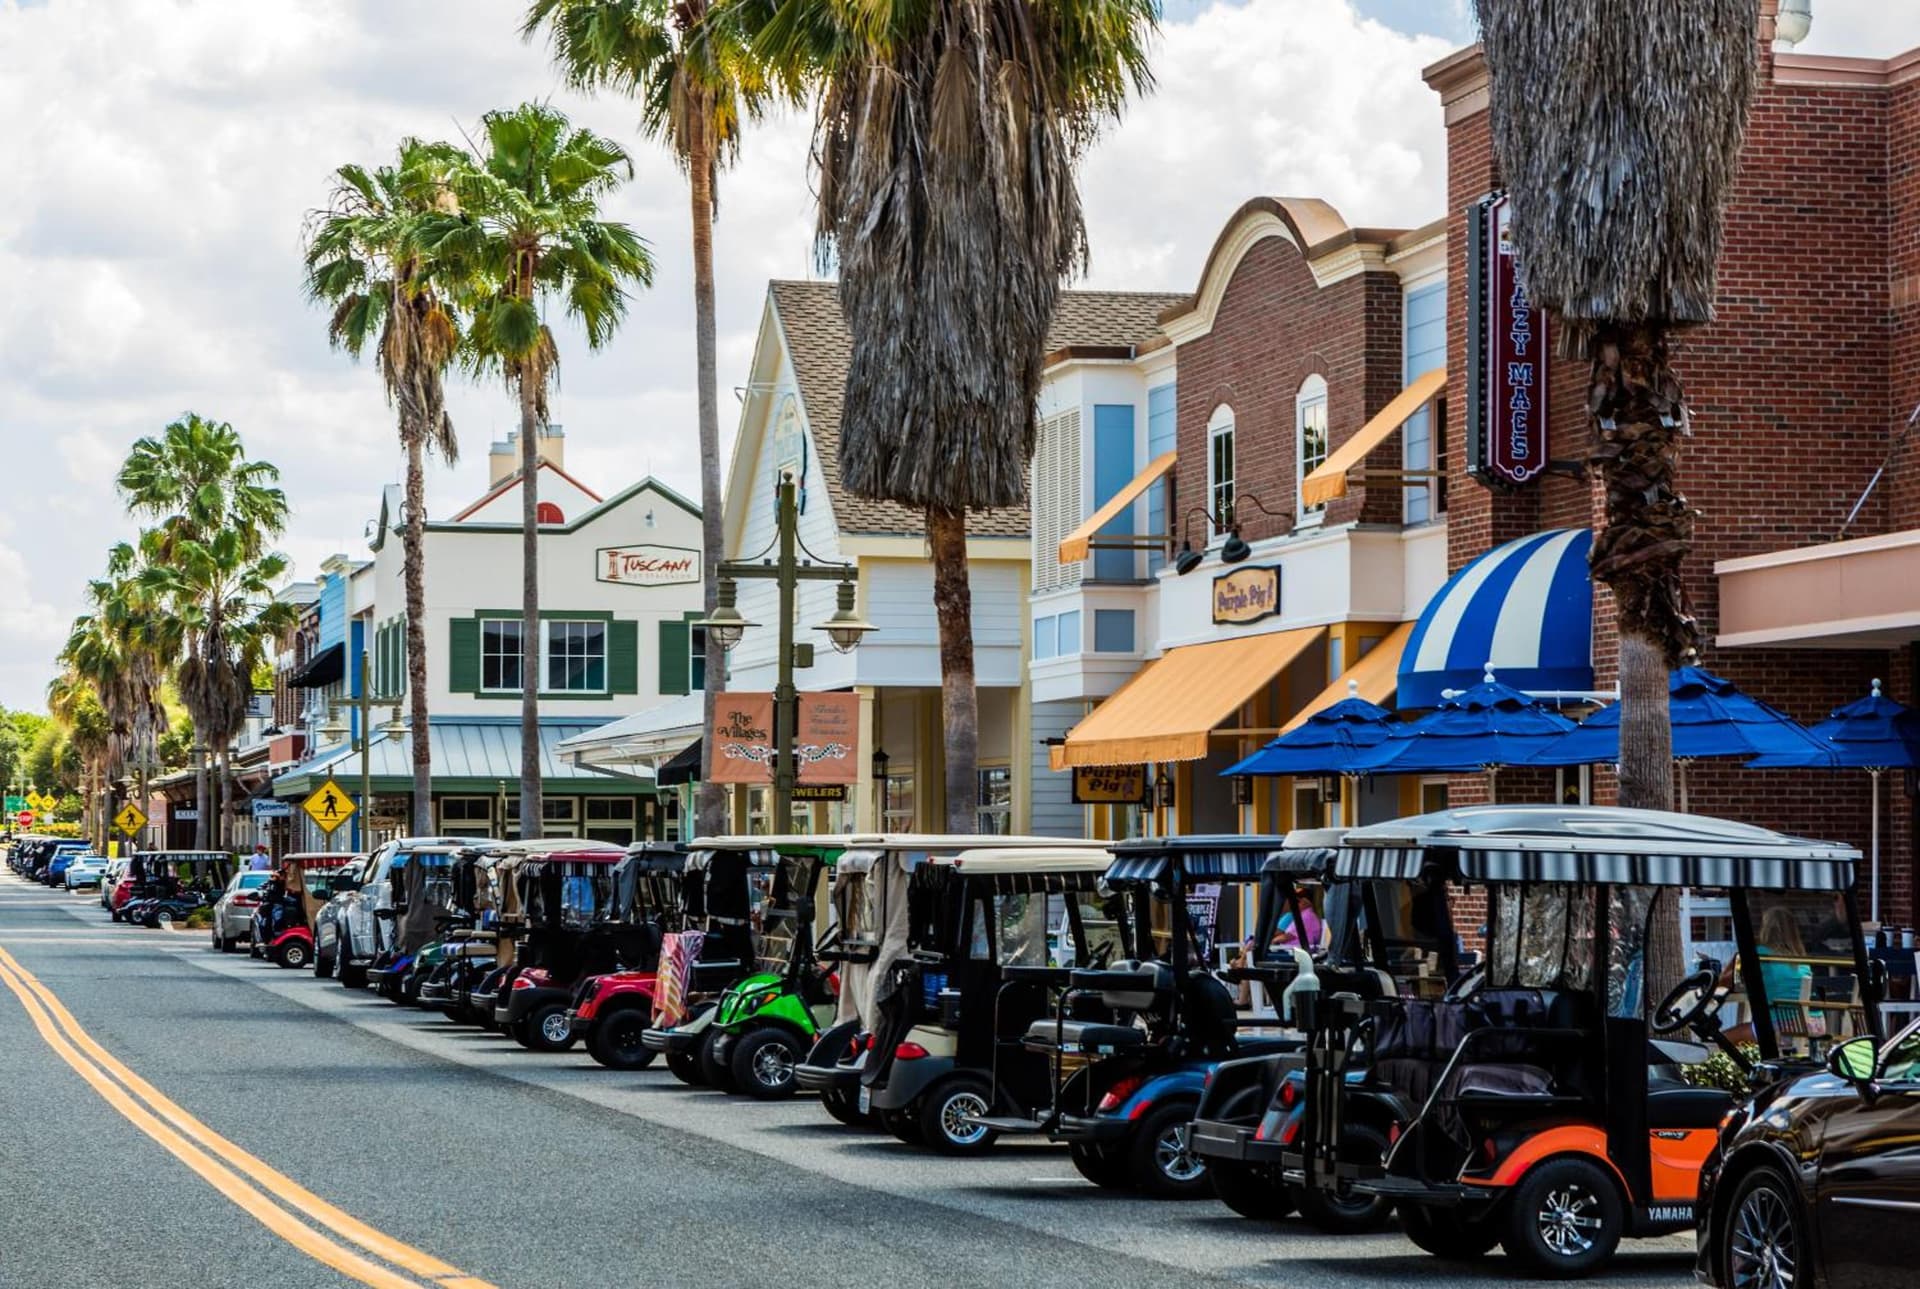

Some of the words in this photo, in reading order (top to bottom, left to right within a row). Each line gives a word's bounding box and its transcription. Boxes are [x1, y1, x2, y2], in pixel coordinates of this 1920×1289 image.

[728, 711, 753, 727] The
[717, 726, 767, 741] Villages
[1080, 764, 1141, 780] Purple
[792, 787, 842, 798] EWELERS
[1088, 778, 1120, 793] Pig
[1648, 1207, 1693, 1221] YAMAHA
